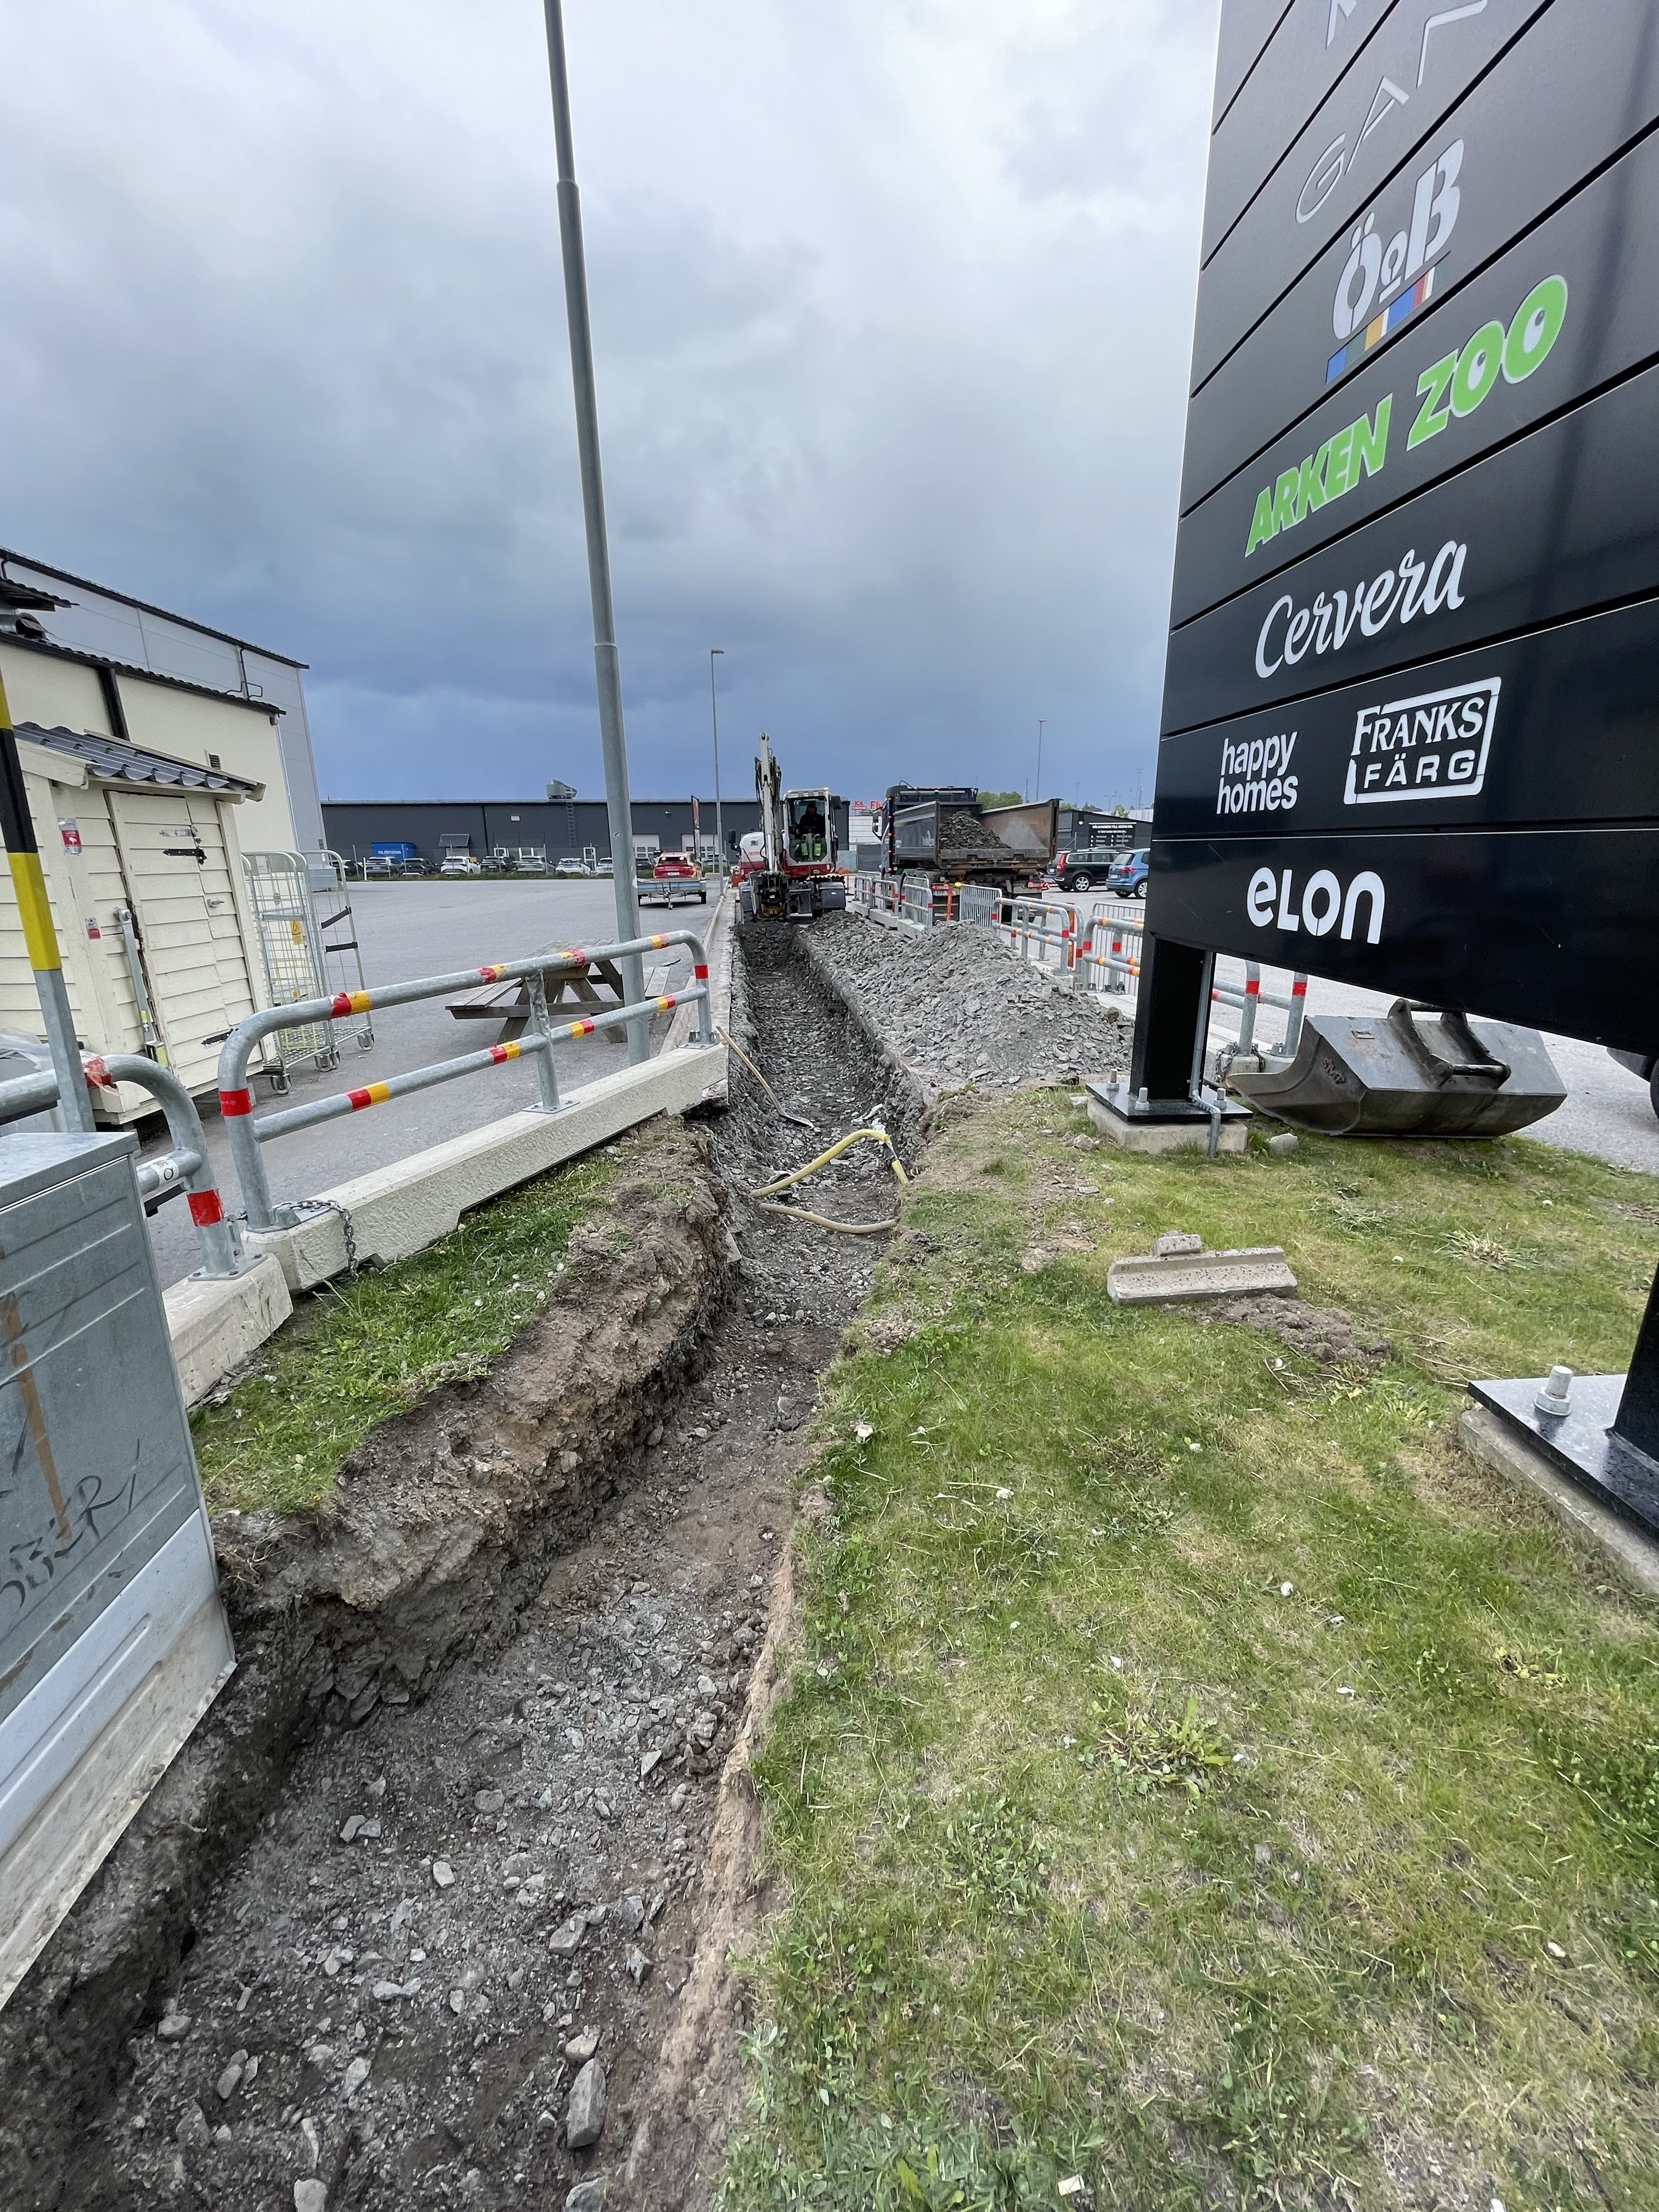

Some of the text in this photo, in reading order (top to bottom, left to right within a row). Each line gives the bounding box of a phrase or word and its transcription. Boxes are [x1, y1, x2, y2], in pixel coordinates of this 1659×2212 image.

[1244, 274, 1568, 558] ARKEN ZOO
[1255, 540, 1468, 678] Cervera
[1351, 697, 1485, 756] FRANKS
[1220, 731, 1298, 781] happy
[1363, 749, 1476, 789] FÄRG
[1216, 775, 1299, 815] homes
